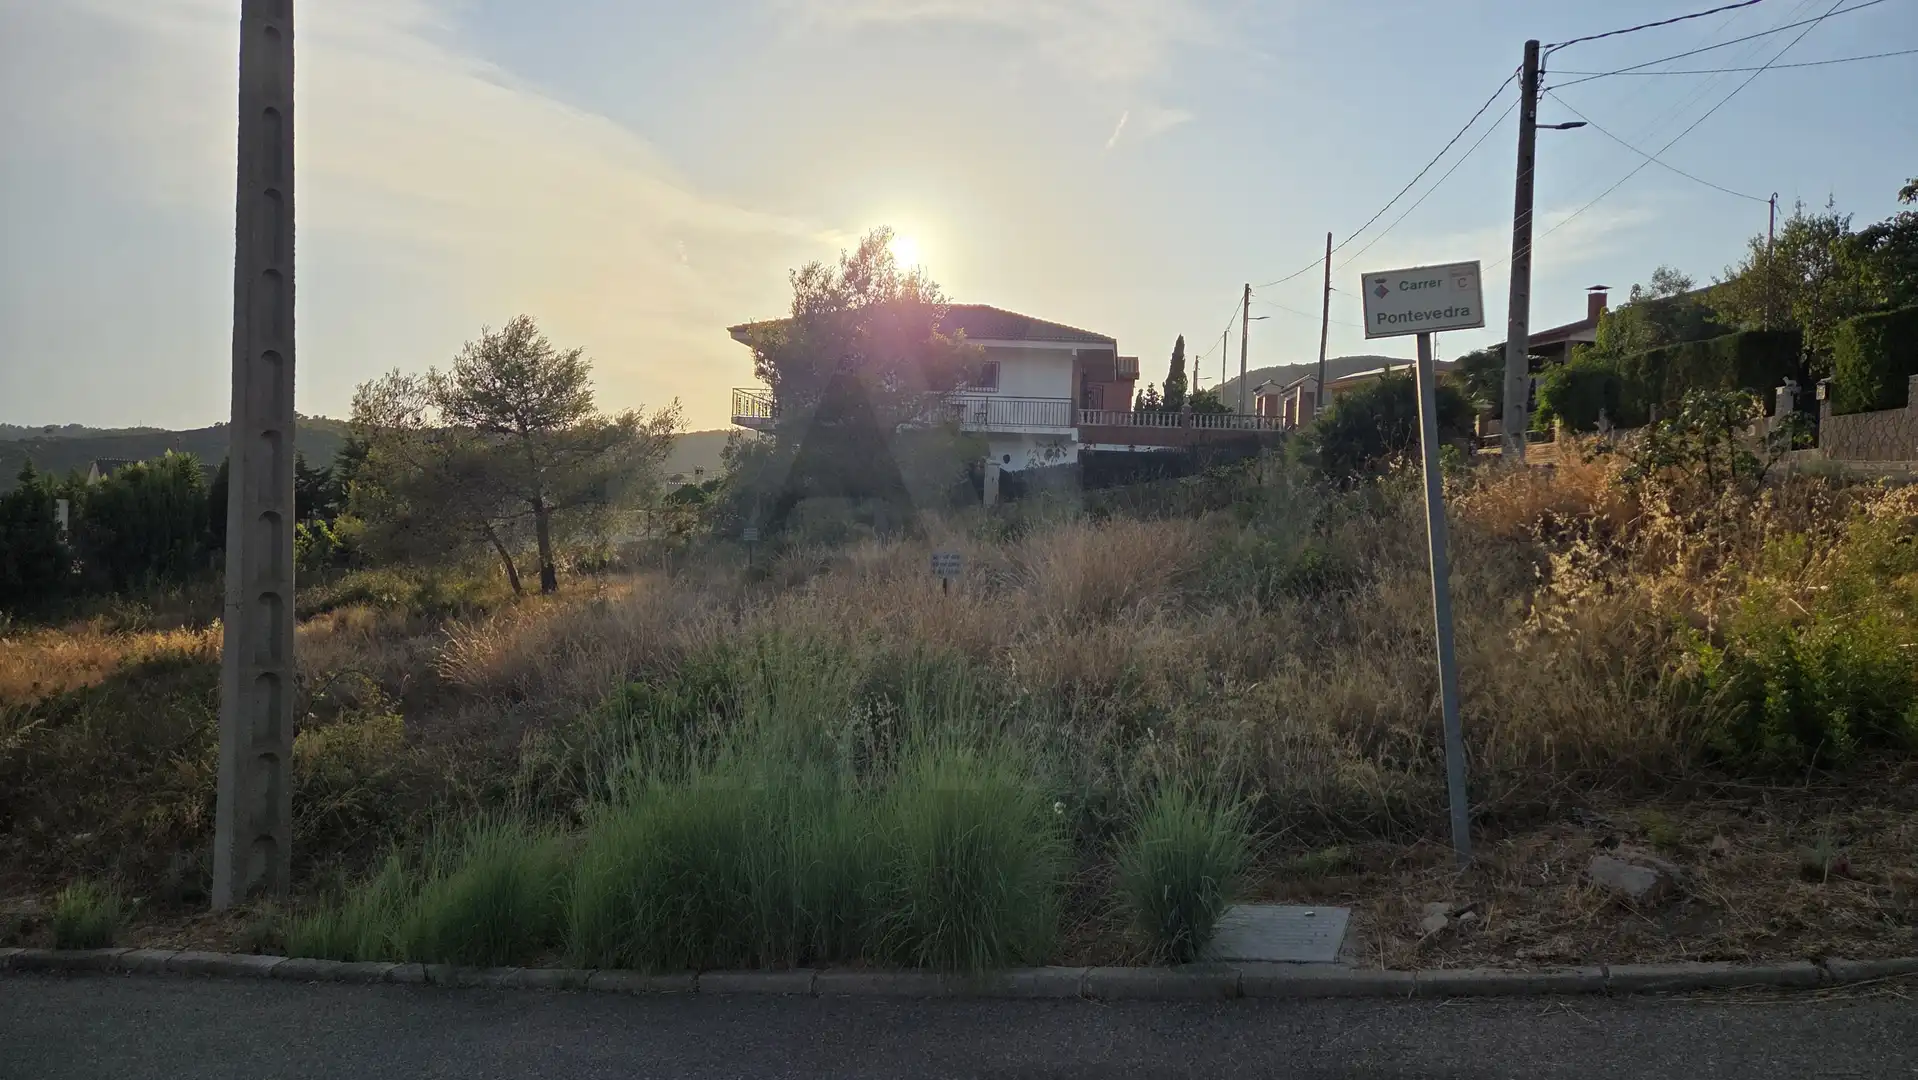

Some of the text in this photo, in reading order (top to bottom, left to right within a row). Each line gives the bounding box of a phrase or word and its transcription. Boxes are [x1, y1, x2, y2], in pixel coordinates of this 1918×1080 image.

[1399, 279, 1443, 291] Carrer
[1458, 277, 1468, 288] C
[1377, 306, 1470, 324] Pontevedra
